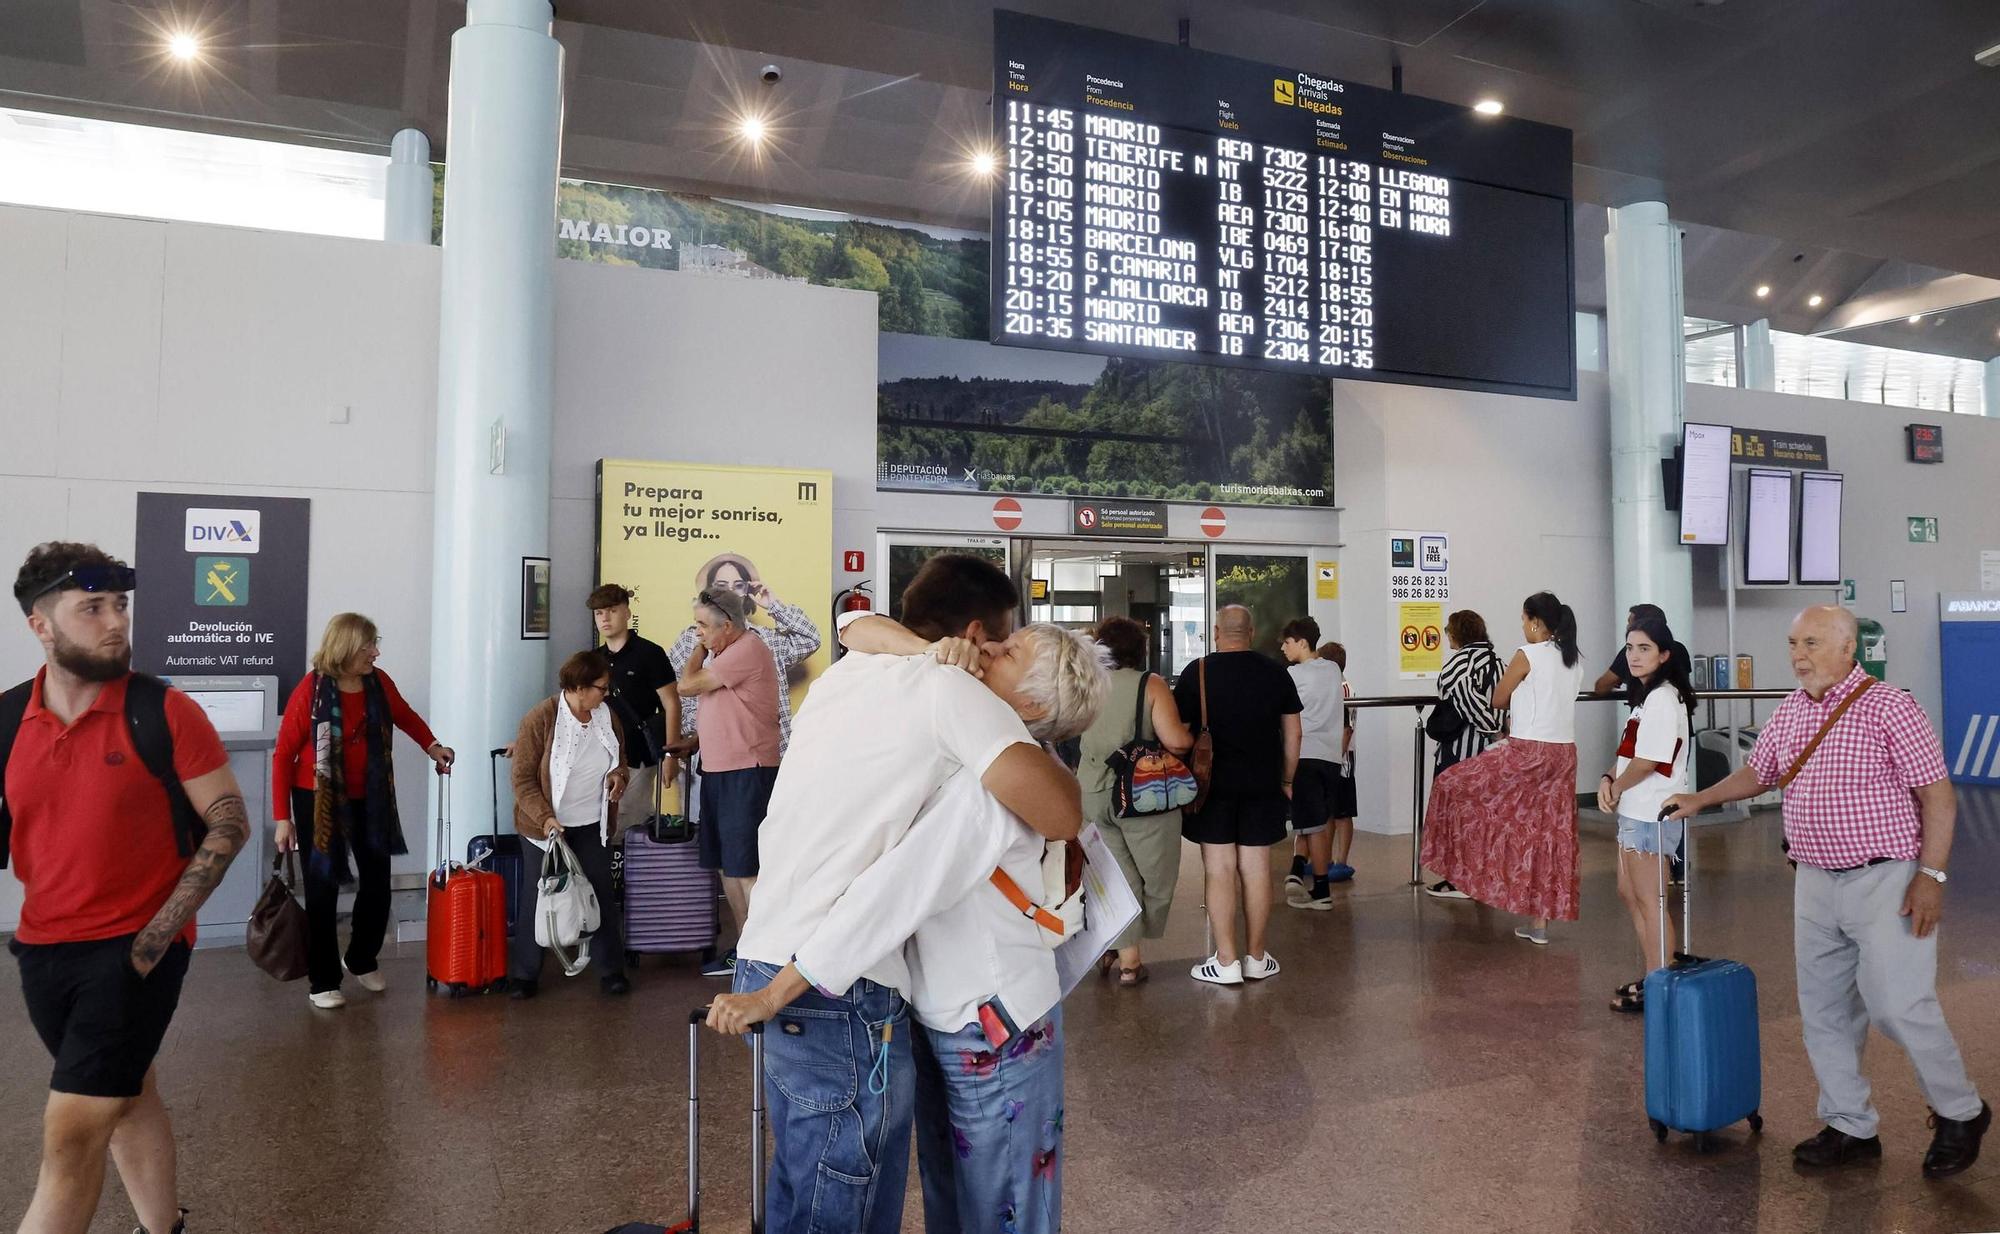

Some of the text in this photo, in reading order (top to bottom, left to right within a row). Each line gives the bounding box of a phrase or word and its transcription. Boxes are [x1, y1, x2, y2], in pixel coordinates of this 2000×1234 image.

[1009, 60, 1025, 70] Hora
[1009, 71, 1025, 81] Time
[1086, 74, 1124, 89] Procedencia
[1009, 81, 1029, 92] Hora
[1298, 73, 1344, 93] Chegadas
[1086, 85, 1102, 95] From
[1298, 86, 1328, 101] Arrivals
[1086, 95, 1134, 111] Procedencia
[1219, 99, 1230, 109] Voo
[1298, 97, 1343, 116] Llegadas
[1219, 109, 1234, 120] Flight
[1219, 119, 1239, 130] Vuelo
[1316, 119, 1341, 130] Estimada
[1316, 129, 1340, 140] Expected
[1382, 132, 1415, 145] Observacions
[1008, 101, 1449, 197] 11:45 MADRID AEA 7302 11:39 LLEGADA
[1317, 138, 1348, 151] Estimada
[1382, 142, 1405, 152] Remarks
[1382, 151, 1428, 166] Observaciones
[1008, 124, 1450, 217] 12:00 TENERIFE N NT 5222 12:00 EN HORA
[1008, 148, 1450, 237] 12:50 MADRID IB 1129 12:40 EN HORA
[1008, 171, 1372, 244] 16:00 MADRID AEA 7300 16:00
[558, 218, 673, 250] MAIOR
[1008, 195, 1372, 265] 17:05 MADRID IBE 0469 17:05
[1008, 218, 1372, 286] 18:15 BARCELONA VLG 1704 18:15
[1008, 241, 1372, 306] 18:55 G.CANARIA NT 5212 18:55
[1007, 265, 1373, 327] 19:20 P.MALLORCA IB 2414 19:20
[1005, 289, 1373, 348] 20:15 MADRID AEA 7306 20:15
[1005, 312, 1374, 369] 20:35 SANTANDER IB 2304 20:35
[1689, 430, 1705, 440] Mpox
[890, 464, 948, 475] DEPUTACIÓN
[890, 473, 948, 484] PONTEVEDRA
[624, 482, 703, 502] Prepara
[1220, 483, 1324, 497] turismoriasbaixas.com
[623, 503, 783, 525] tu mejor sonrisa,
[623, 521, 720, 542] ya llega...
[1113, 521, 1136, 529] personal
[1427, 546, 1439, 554] TAX
[1426, 554, 1441, 562] FREE
[1392, 576, 1448, 586] 986 26 82 31
[1392, 588, 1449, 599] 986 26 82 93
[189, 621, 253, 632] Devolución
[167, 632, 274, 643] automática do IVE
[165, 655, 273, 666] Automatic VAT refund
